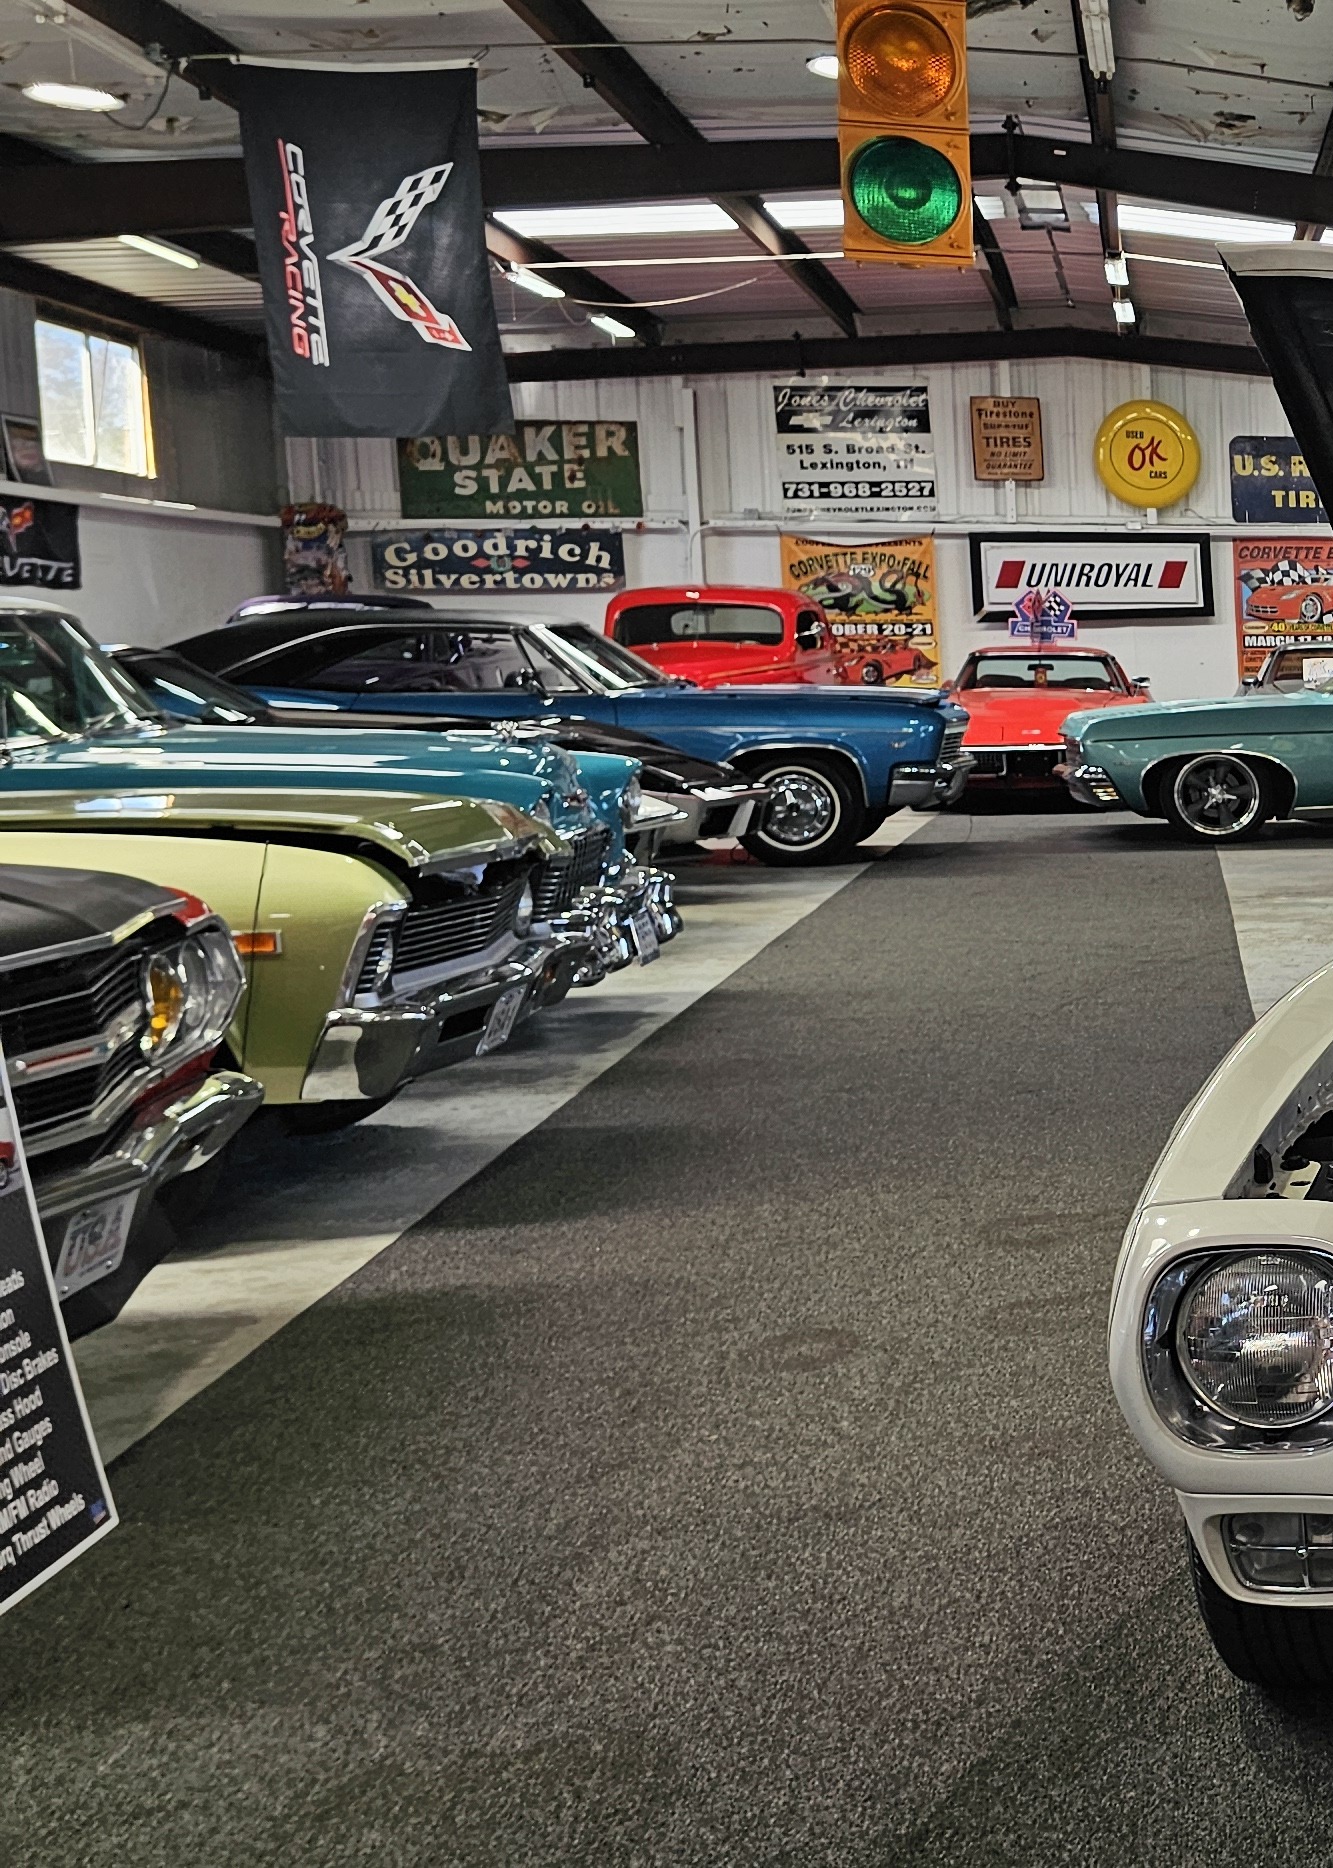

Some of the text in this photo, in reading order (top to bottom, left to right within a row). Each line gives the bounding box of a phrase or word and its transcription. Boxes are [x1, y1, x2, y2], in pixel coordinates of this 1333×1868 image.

[285, 142, 330, 367] CORVETTE
[278, 190, 311, 359] RACING
[776, 388, 928, 412] Jones Chevrolet
[993, 400, 1016, 408] BUY
[838, 413, 918, 432] Lexington
[976, 408, 1034, 419] Firestone
[982, 435, 1032, 448] TIRES
[1126, 430, 1144, 439] USED
[406, 423, 630, 471] QUAKER
[786, 443, 926, 455] 515 S. Broad St.
[1127, 435, 1168, 471] OK
[800, 458, 886, 472] Lexington,
[1149, 470, 1168, 479] CARS
[1233, 455, 1284, 476] U.S.
[453, 463, 587, 496] STATE
[784, 482, 933, 497] 731-968-2527
[485, 500, 620, 514] MOTOR OIL
[1272, 490, 1324, 508] TIR
[384, 532, 612, 569] Goodrich
[1238, 546, 1323, 559] CORVETTE
[0, 555, 74, 583] VETTE
[789, 552, 857, 579] CORVETTE
[1026, 562, 1153, 588] UNIROYAL
[384, 568, 616, 589] Silvertowns
[832, 623, 932, 636] OBER 20-21
[1271, 622, 1286, 632] 40
[1244, 635, 1295, 647] MARCH
[22, 1347, 60, 1381] Brakes
[13, 1384, 44, 1419] Hood
[12, 1416, 53, 1453] Gauges
[9, 1450, 45, 1489] Wheel
[26, 1478, 60, 1512] Radio
[11, 1516, 51, 1556] Thrust
[46, 1492, 86, 1531] Wheels
